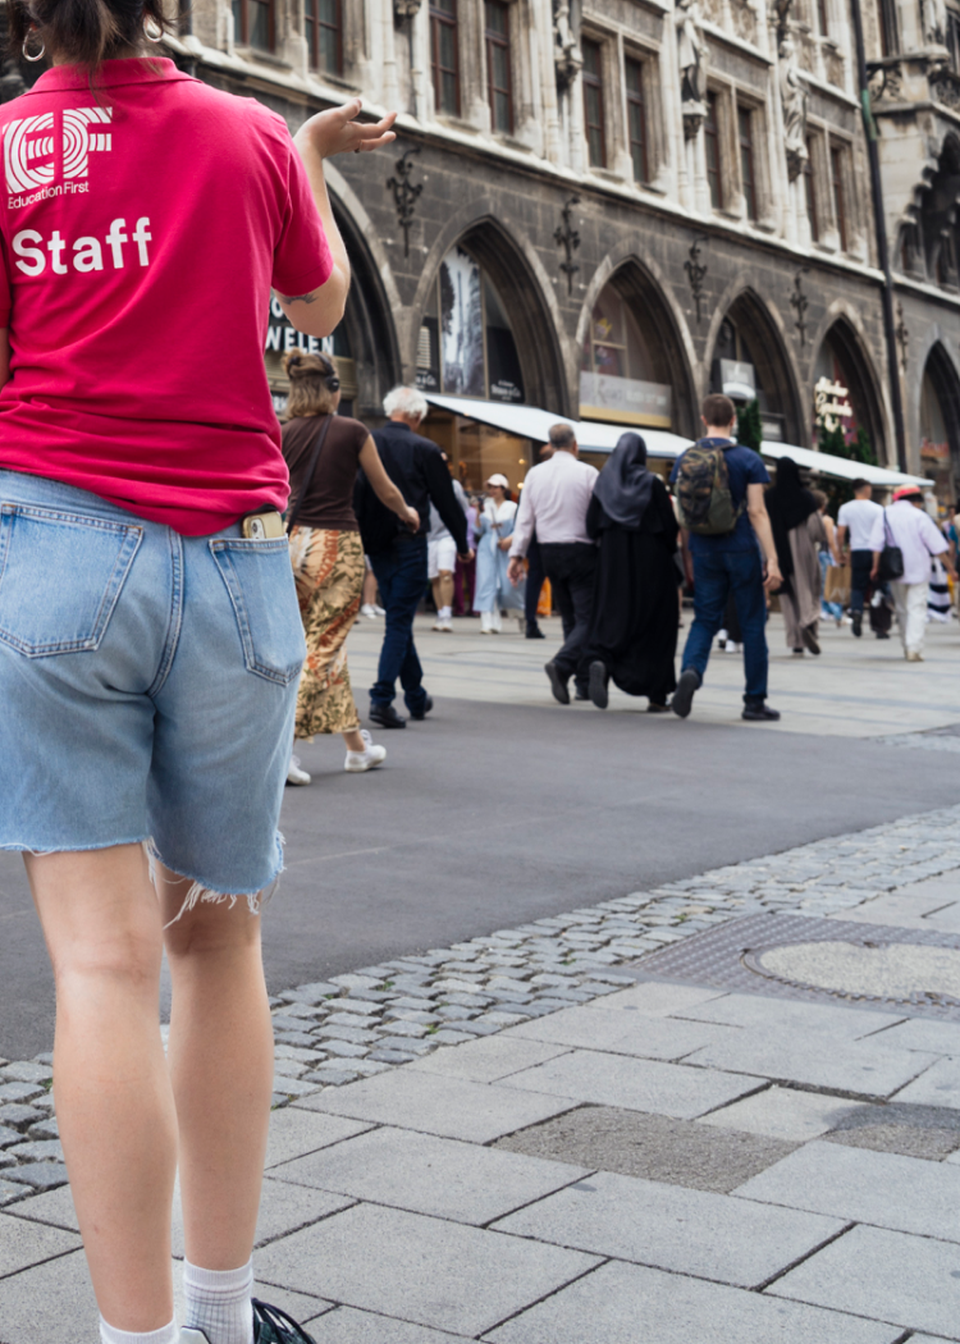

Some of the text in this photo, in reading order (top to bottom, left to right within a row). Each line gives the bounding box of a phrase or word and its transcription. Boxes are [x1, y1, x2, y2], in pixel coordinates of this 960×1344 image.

[8, 180, 89, 209] Education First
[12, 216, 152, 277] Staff
